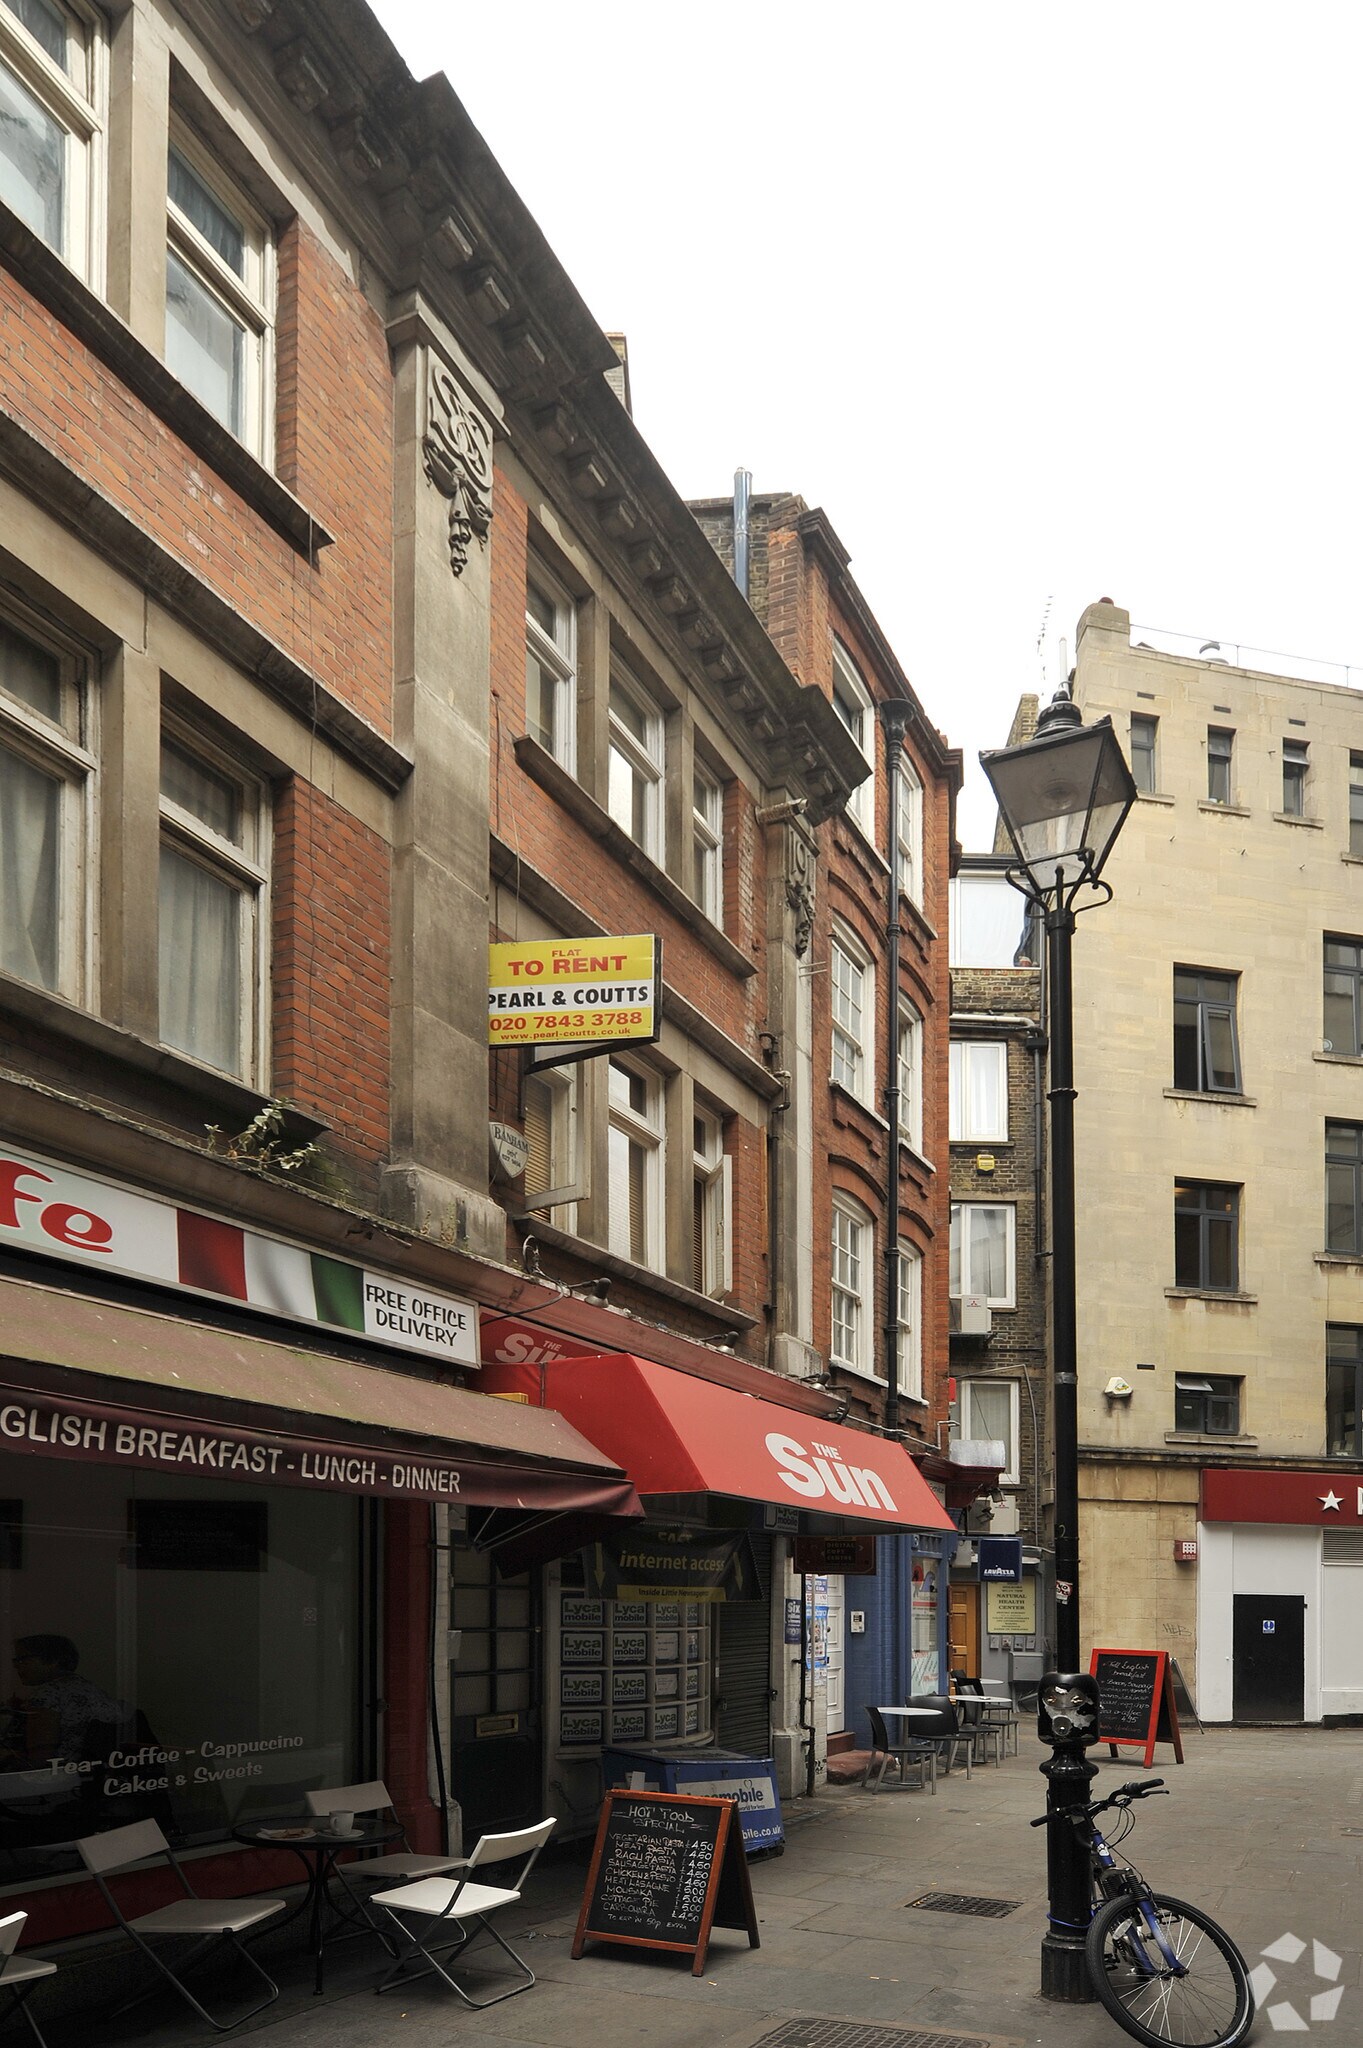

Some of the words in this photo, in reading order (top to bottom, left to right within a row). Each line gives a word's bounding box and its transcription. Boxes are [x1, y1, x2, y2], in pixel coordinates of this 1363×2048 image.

[552, 949, 581, 957] FLAT
[508, 960, 544, 976] TO
[553, 955, 627, 974] RENT
[489, 992, 546, 1008] PEARL
[552, 990, 566, 1006] &
[574, 986, 648, 1005] COUTTS
[490, 1017, 526, 1031] 020
[533, 1014, 585, 1029] 7843
[591, 1011, 642, 1026] 3788
[501, 1027, 631, 1040] www.pearl-coutts.co.uk
[366, 1284, 407, 1312] FREE
[412, 1298, 466, 1330] OFFICE
[376, 1308, 457, 1346] DELIVERY
[543, 1340, 562, 1351] THE
[811, 1441, 842, 1460] THE
[116, 1425, 283, 1474] BREAKFAST
[301, 1453, 376, 1485] LUNCH
[392, 1464, 461, 1493] DINNER
[765, 1432, 898, 1512] Sun
[619, 1550, 687, 1570] internet
[690, 1558, 724, 1571] access
[984, 1567, 1015, 1575] LAVAZZA
[639, 1588, 661, 1597] Inside
[564, 1601, 600, 1615] Lyca
[614, 1602, 645, 1615] Lyca
[656, 1603, 678, 1616] Lyca
[564, 1613, 600, 1621] mobile
[614, 1614, 645, 1622] mobile
[656, 1614, 678, 1622] mobile
[564, 1638, 600, 1650] Lyca
[614, 1637, 645, 1649] Lyca
[564, 1648, 600, 1656] mobile
[614, 1648, 645, 1656] mobile
[564, 1678, 600, 1690] Lyca
[614, 1678, 645, 1690] Lyca
[564, 1688, 600, 1697] mobile
[614, 1688, 645, 1696] mobile
[563, 1717, 600, 1730] Lyca
[614, 1715, 644, 1727] Lyca
[655, 1713, 676, 1724] Lyca
[562, 1727, 600, 1736] mobile
[613, 1725, 644, 1734] mobile
[654, 1722, 676, 1731] mobile
[109, 1745, 180, 1769] Coffee
[201, 1735, 304, 1759] Cappuccino
[103, 1774, 169, 1797] Cakes
[175, 1774, 187, 1786] &
[193, 1760, 263, 1784] Sweets
[630, 1805, 655, 1818] HOT
[633, 1818, 684, 1834] SPECIAL
[616, 1841, 644, 1851] MEAT
[645, 1852, 676, 1867] PASTA
[605, 1867, 643, 1880] CHICKEN
[604, 1875, 628, 1886] MEAT
[628, 1879, 670, 1893] LASAGNE
